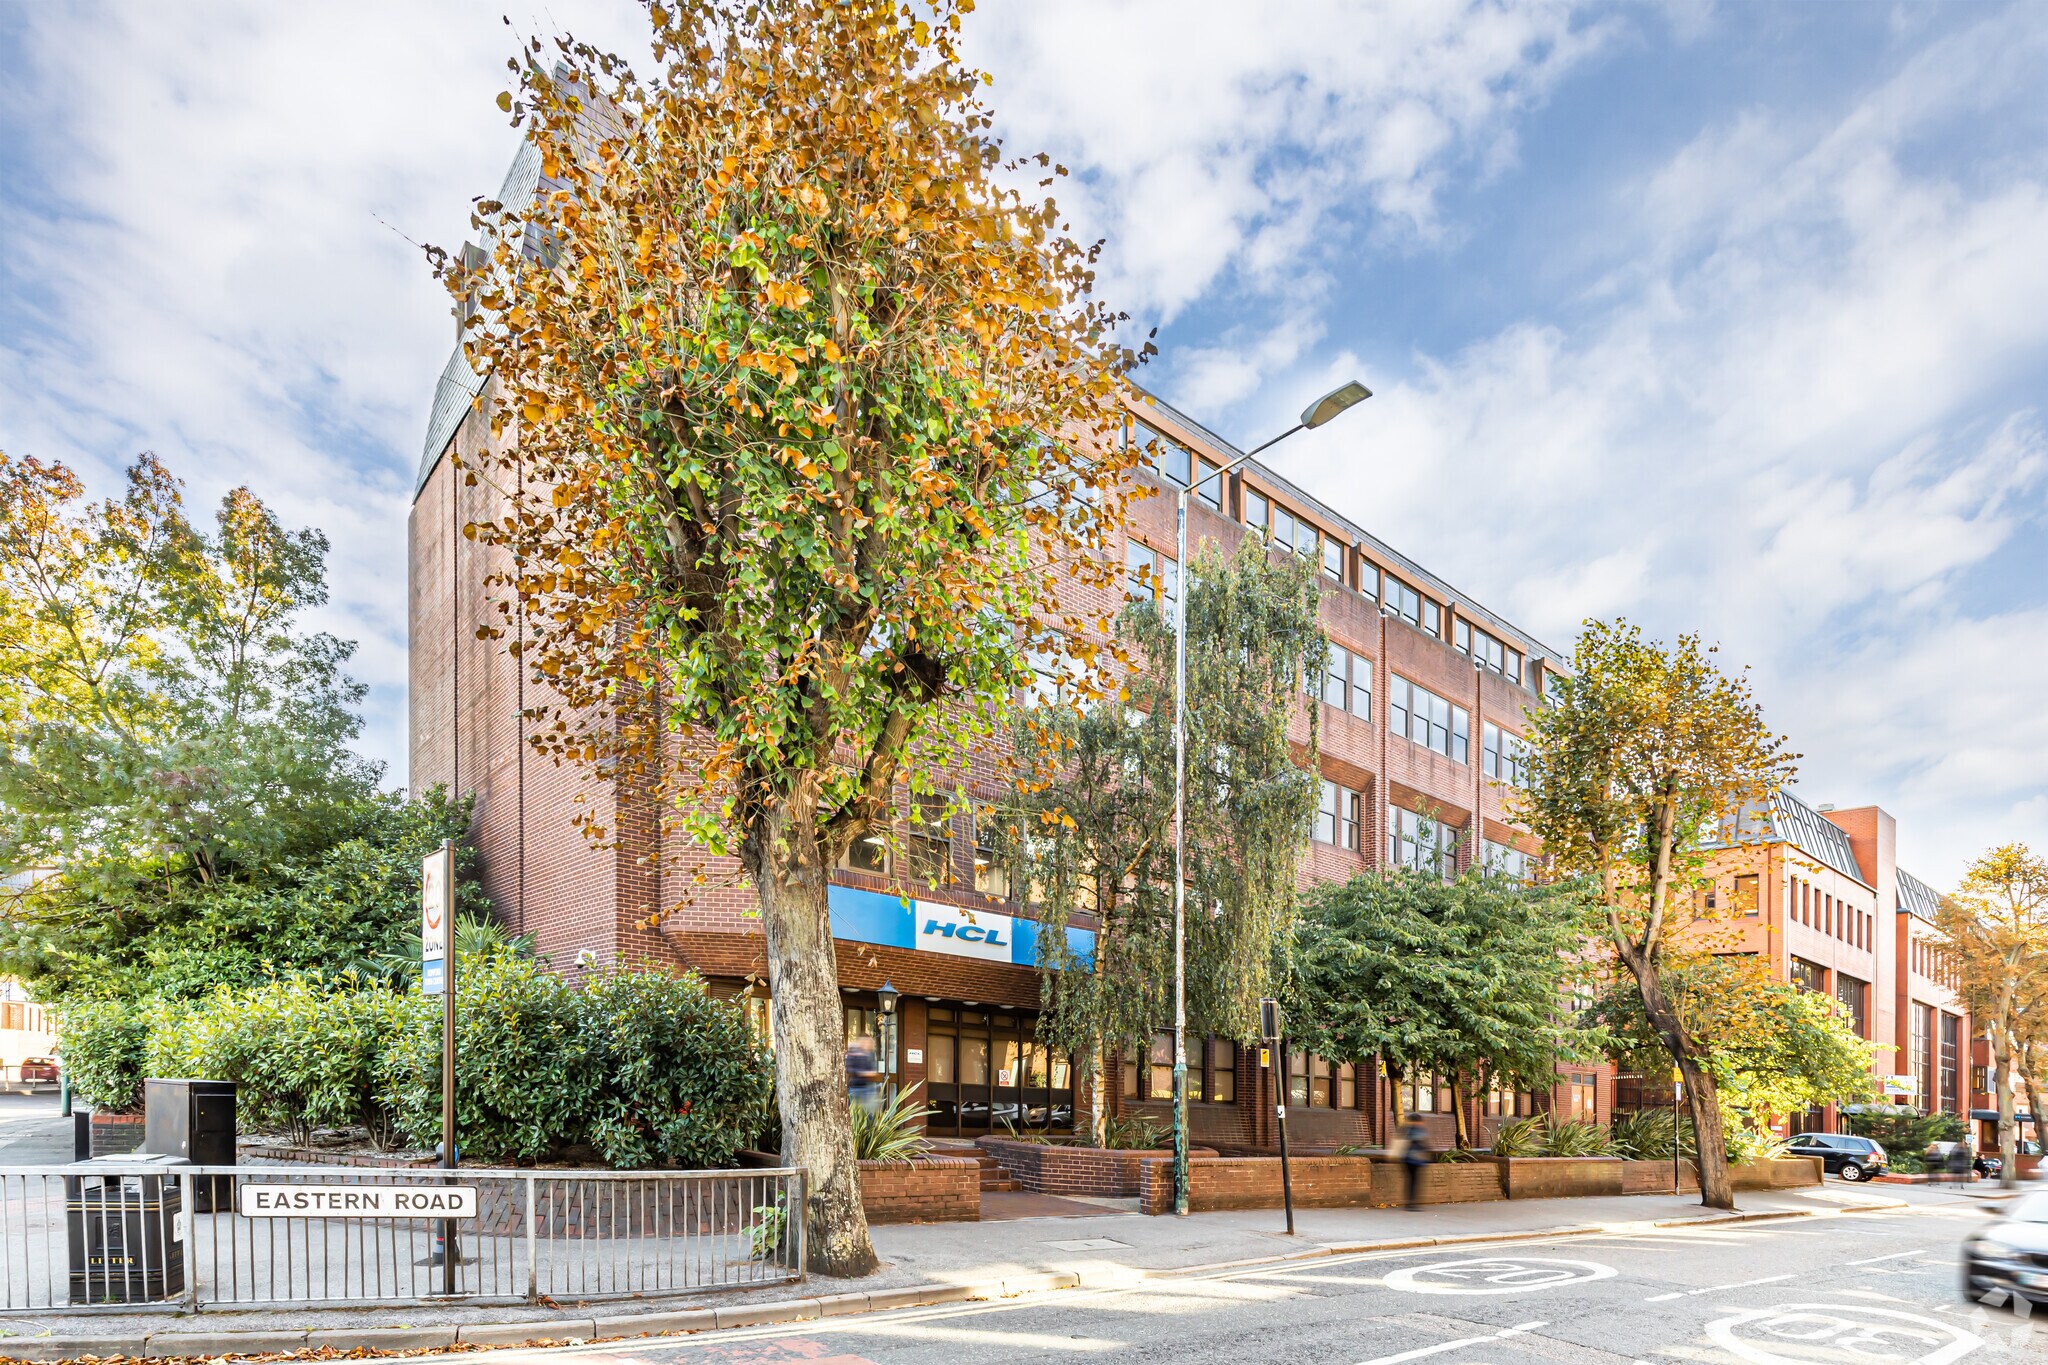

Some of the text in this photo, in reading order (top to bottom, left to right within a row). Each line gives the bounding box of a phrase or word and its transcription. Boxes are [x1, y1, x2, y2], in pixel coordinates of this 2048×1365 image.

[923, 919, 1008, 946] HCL
[256, 1192, 464, 1210] EASTERN ROAD
